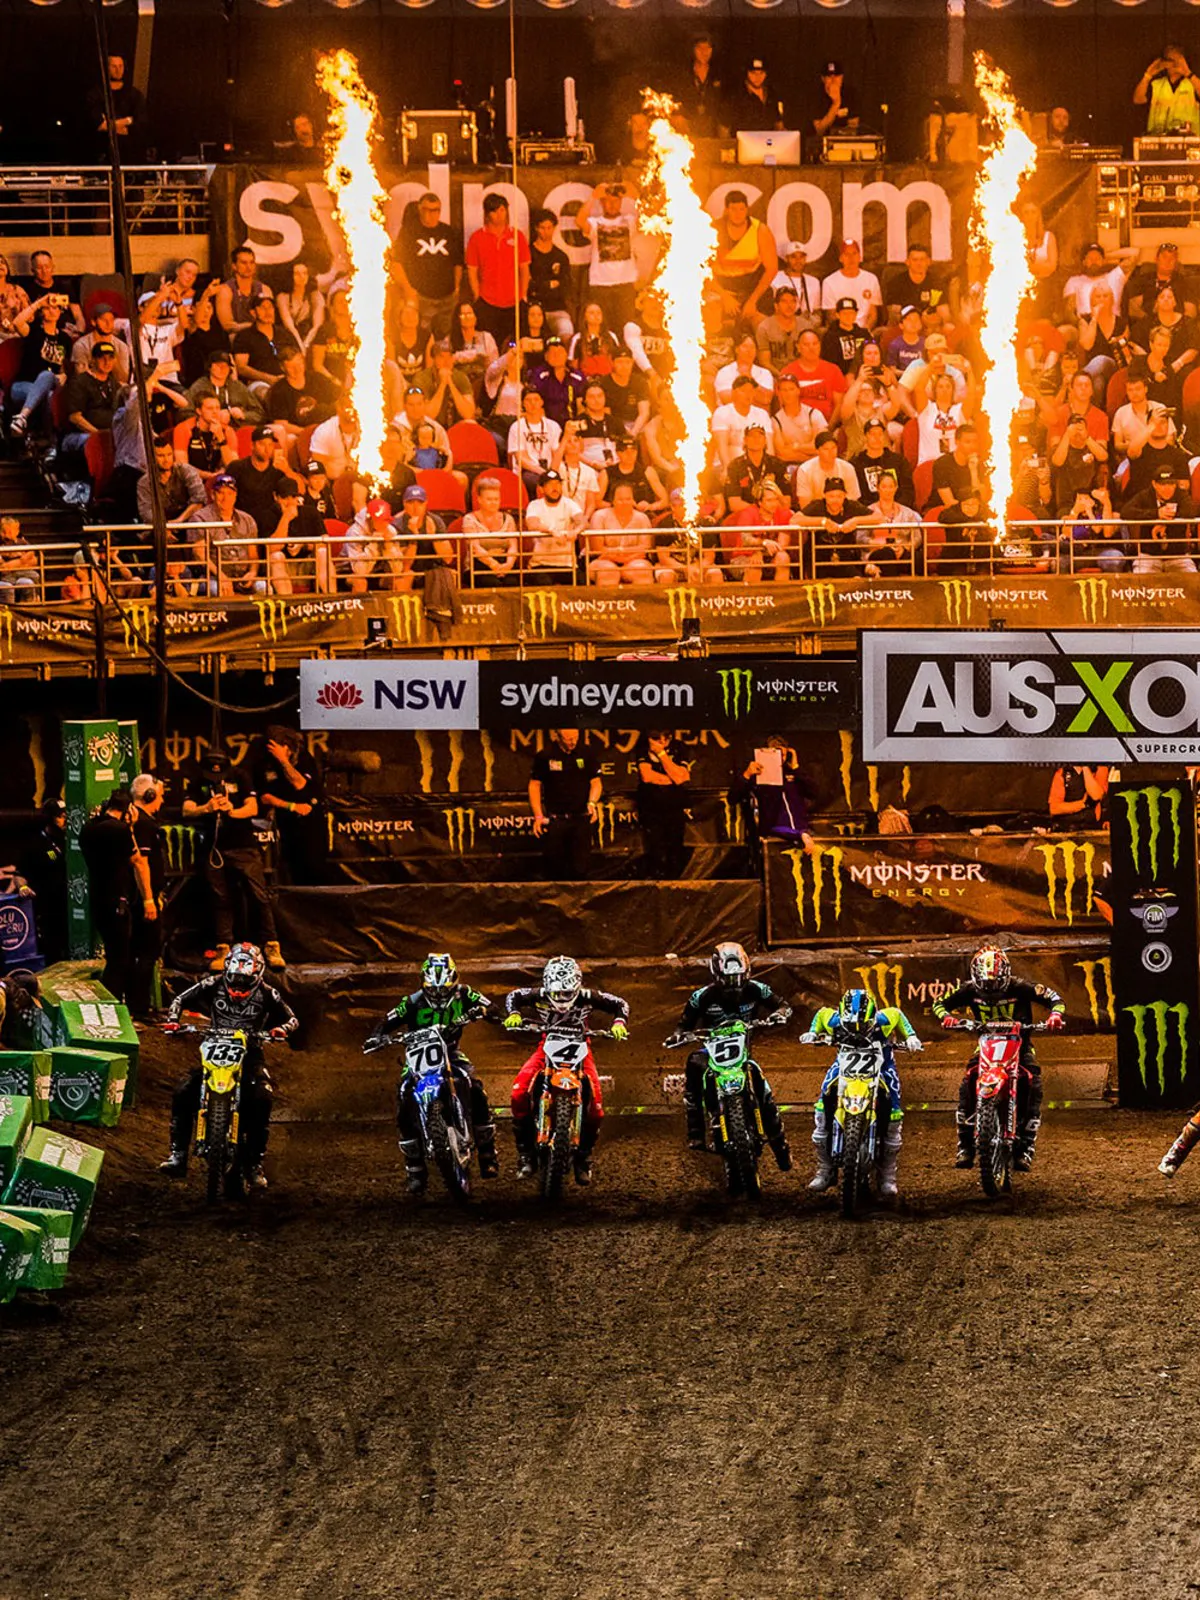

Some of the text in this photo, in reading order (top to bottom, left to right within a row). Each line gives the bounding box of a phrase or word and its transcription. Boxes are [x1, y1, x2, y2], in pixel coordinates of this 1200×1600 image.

[839, 589, 914, 602] MONSTER
[975, 588, 1049, 602] MONSTER
[1112, 586, 1186, 599] MONSTER
[290, 599, 364, 617] MONSTER
[561, 598, 636, 613] MONSTER
[700, 595, 776, 610] MONSTER
[302, 613, 353, 623] ENERGY
[16, 619, 92, 635] MONSTER
[756, 678, 840, 694] MONSTER
[374, 679, 467, 710] NSW
[500, 676, 694, 714] sydney.com
[509, 730, 730, 752] MNSER
[139, 730, 330, 771] MOSR
[338, 820, 414, 834] MONSTER
[479, 815, 538, 830] MONST
[850, 860, 986, 883] MONSTER
[872, 887, 966, 897] ENERGY
[1146, 911, 1163, 922] FIM
[205, 1045, 243, 1062] 133
[408, 1044, 443, 1074] 70
[551, 1042, 580, 1062] 4
[715, 1038, 742, 1066] 5
[991, 1041, 1008, 1061] 1
[844, 1053, 878, 1074] 22
